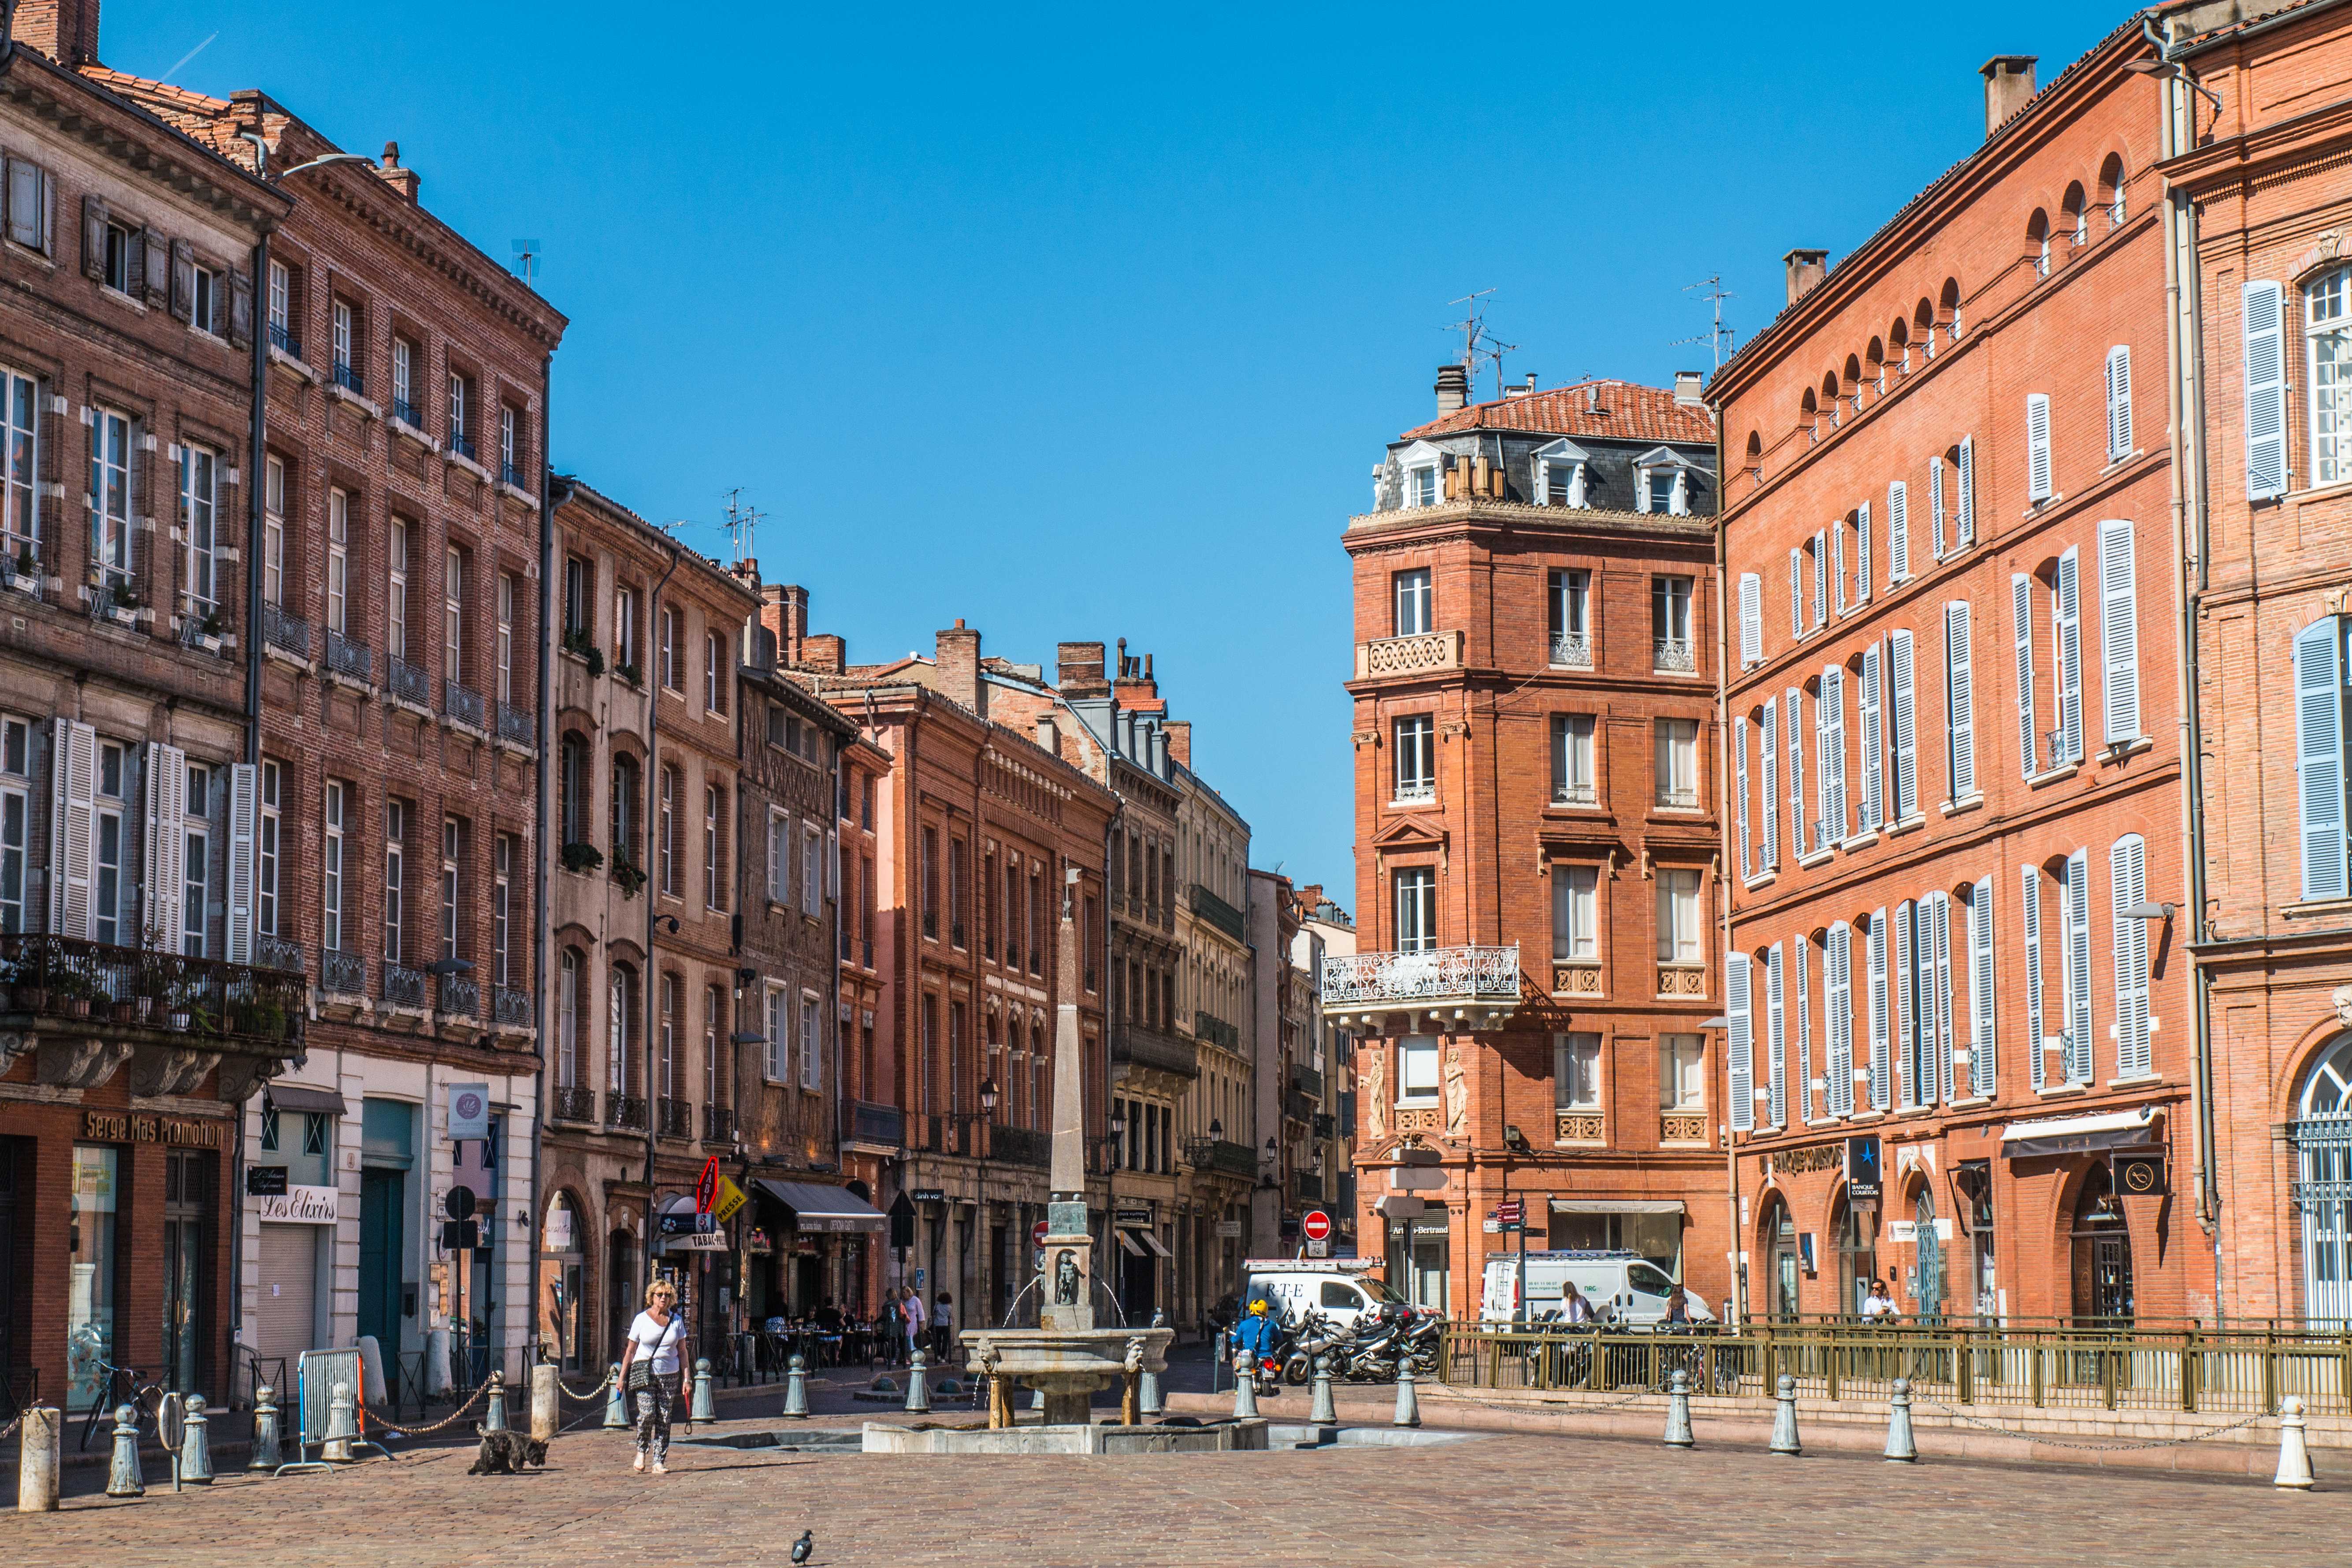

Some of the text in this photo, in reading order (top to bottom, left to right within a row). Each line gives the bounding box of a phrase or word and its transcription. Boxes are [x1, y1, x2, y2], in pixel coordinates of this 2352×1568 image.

[88, 1111, 223, 1146] Serge Mas Promotion
[262, 1189, 335, 1219] Les Elixirs
[717, 1195, 743, 1220] PRESSE
[1393, 1226, 1448, 1234] Arts-Bertrand
[1265, 1283, 1303, 1297] R-T-E
